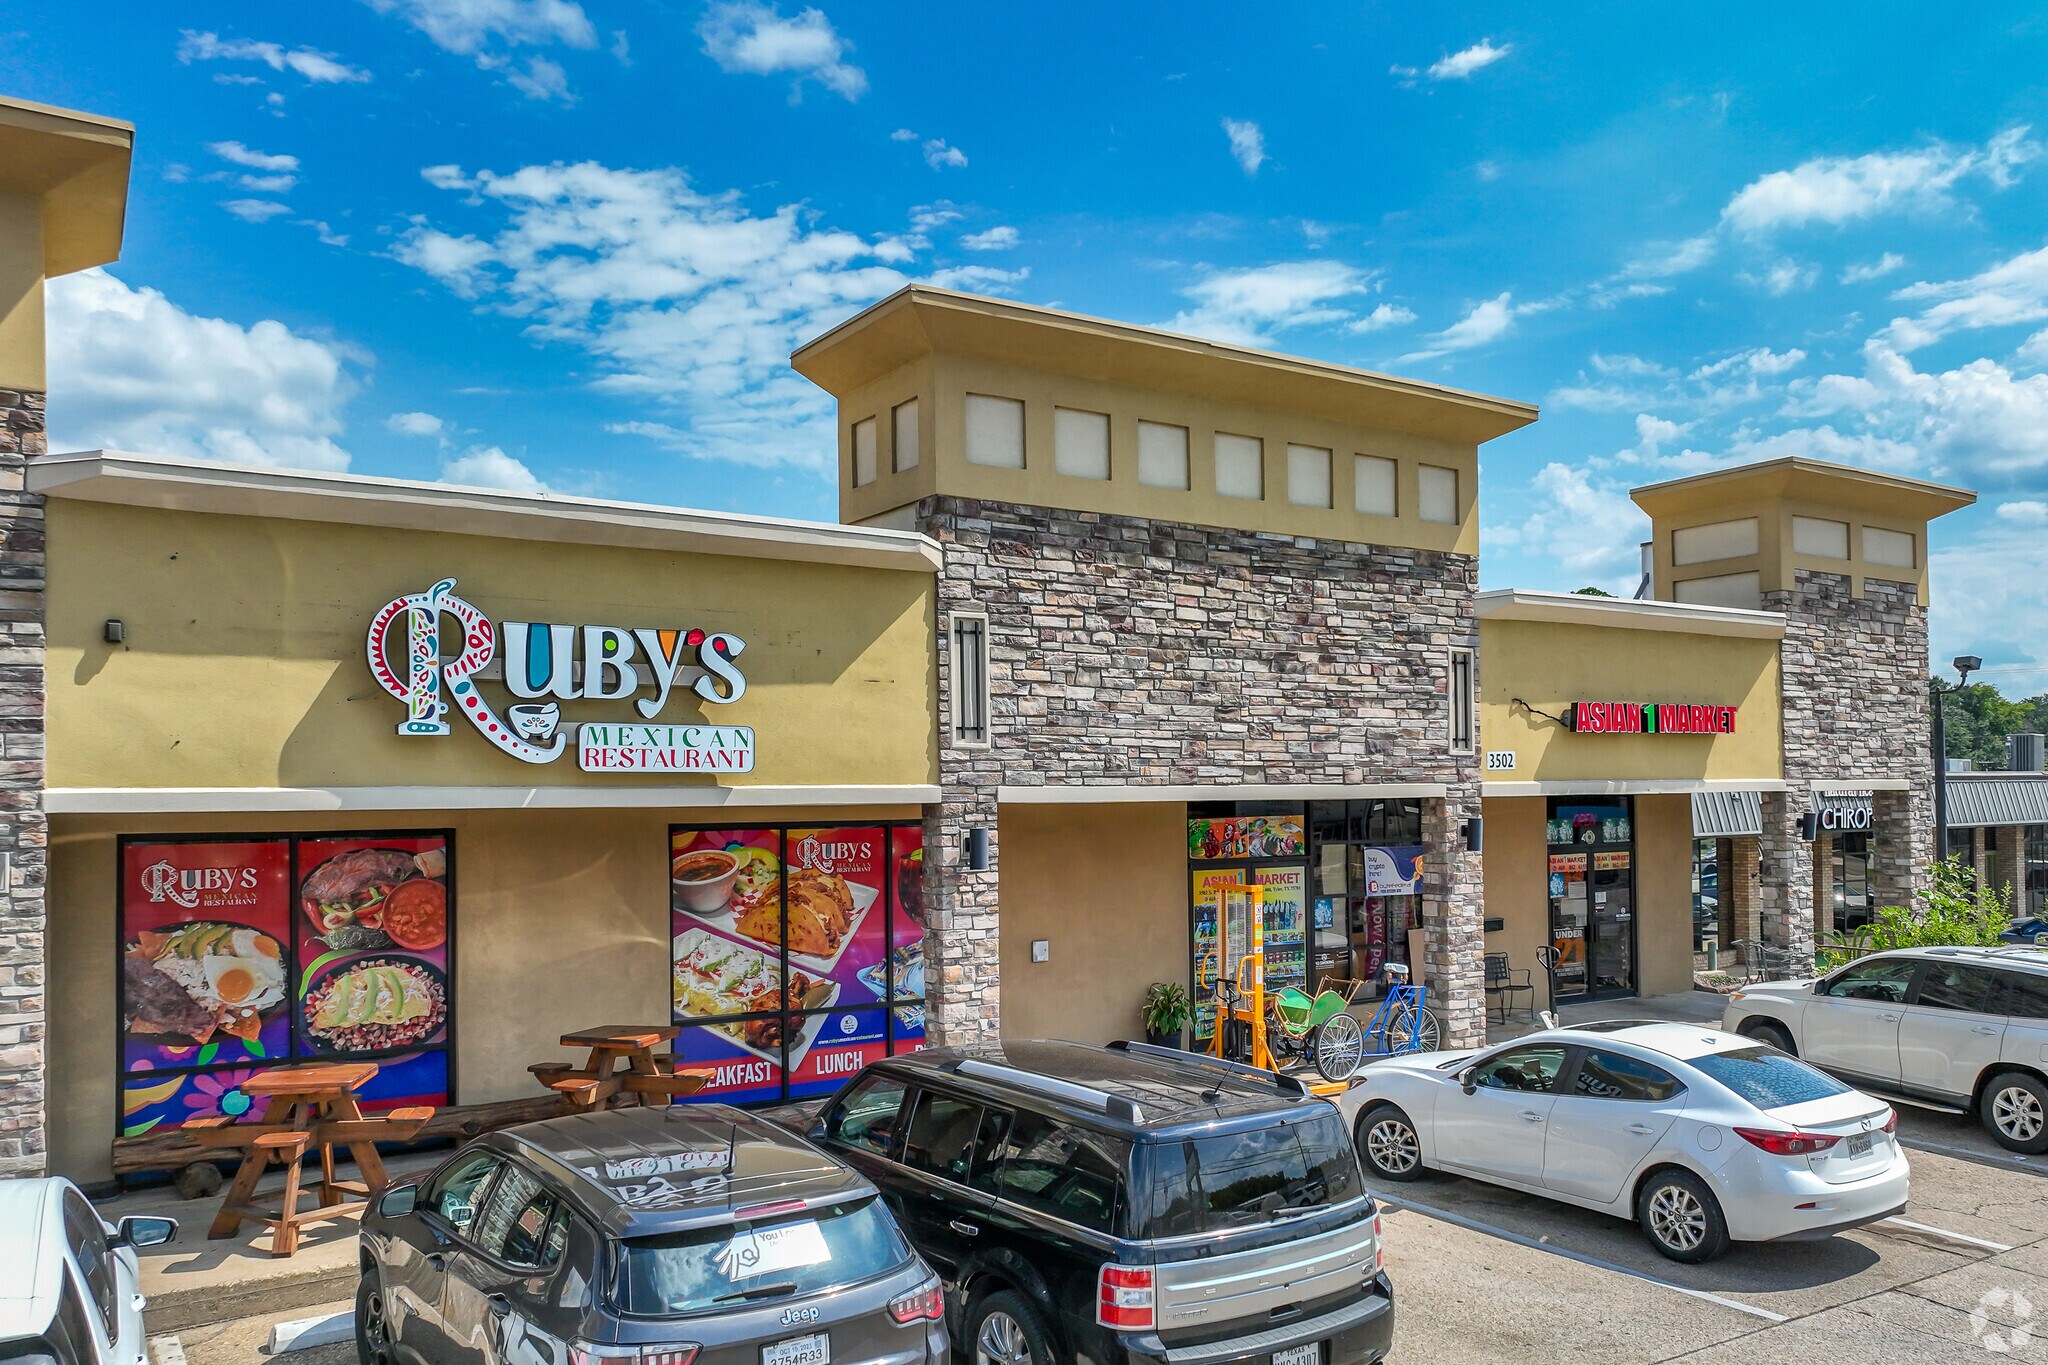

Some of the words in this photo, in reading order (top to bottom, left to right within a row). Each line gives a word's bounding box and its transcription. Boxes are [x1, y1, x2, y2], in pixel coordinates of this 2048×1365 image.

[1576, 701, 1641, 733] ASIAN
[1643, 703, 1655, 733] 1
[1659, 704, 1737, 734] MARKET
[586, 726, 750, 747] MEXICAN
[585, 747, 749, 769] RESTAURANT
[1489, 753, 1513, 769] 3502
[1202, 875, 1237, 888] ASIAN
[1255, 872, 1300, 885] MARKET
[1555, 929, 1583, 939] UNDER
[1554, 938, 1584, 967] 21
[705, 1062, 771, 1088] EAKFAST
[816, 1051, 863, 1075] LUNCH
[780, 1306, 820, 1325] Jeep
[780, 1348, 790, 1356] OCT
[1287, 1346, 1305, 1356] TEXAS
